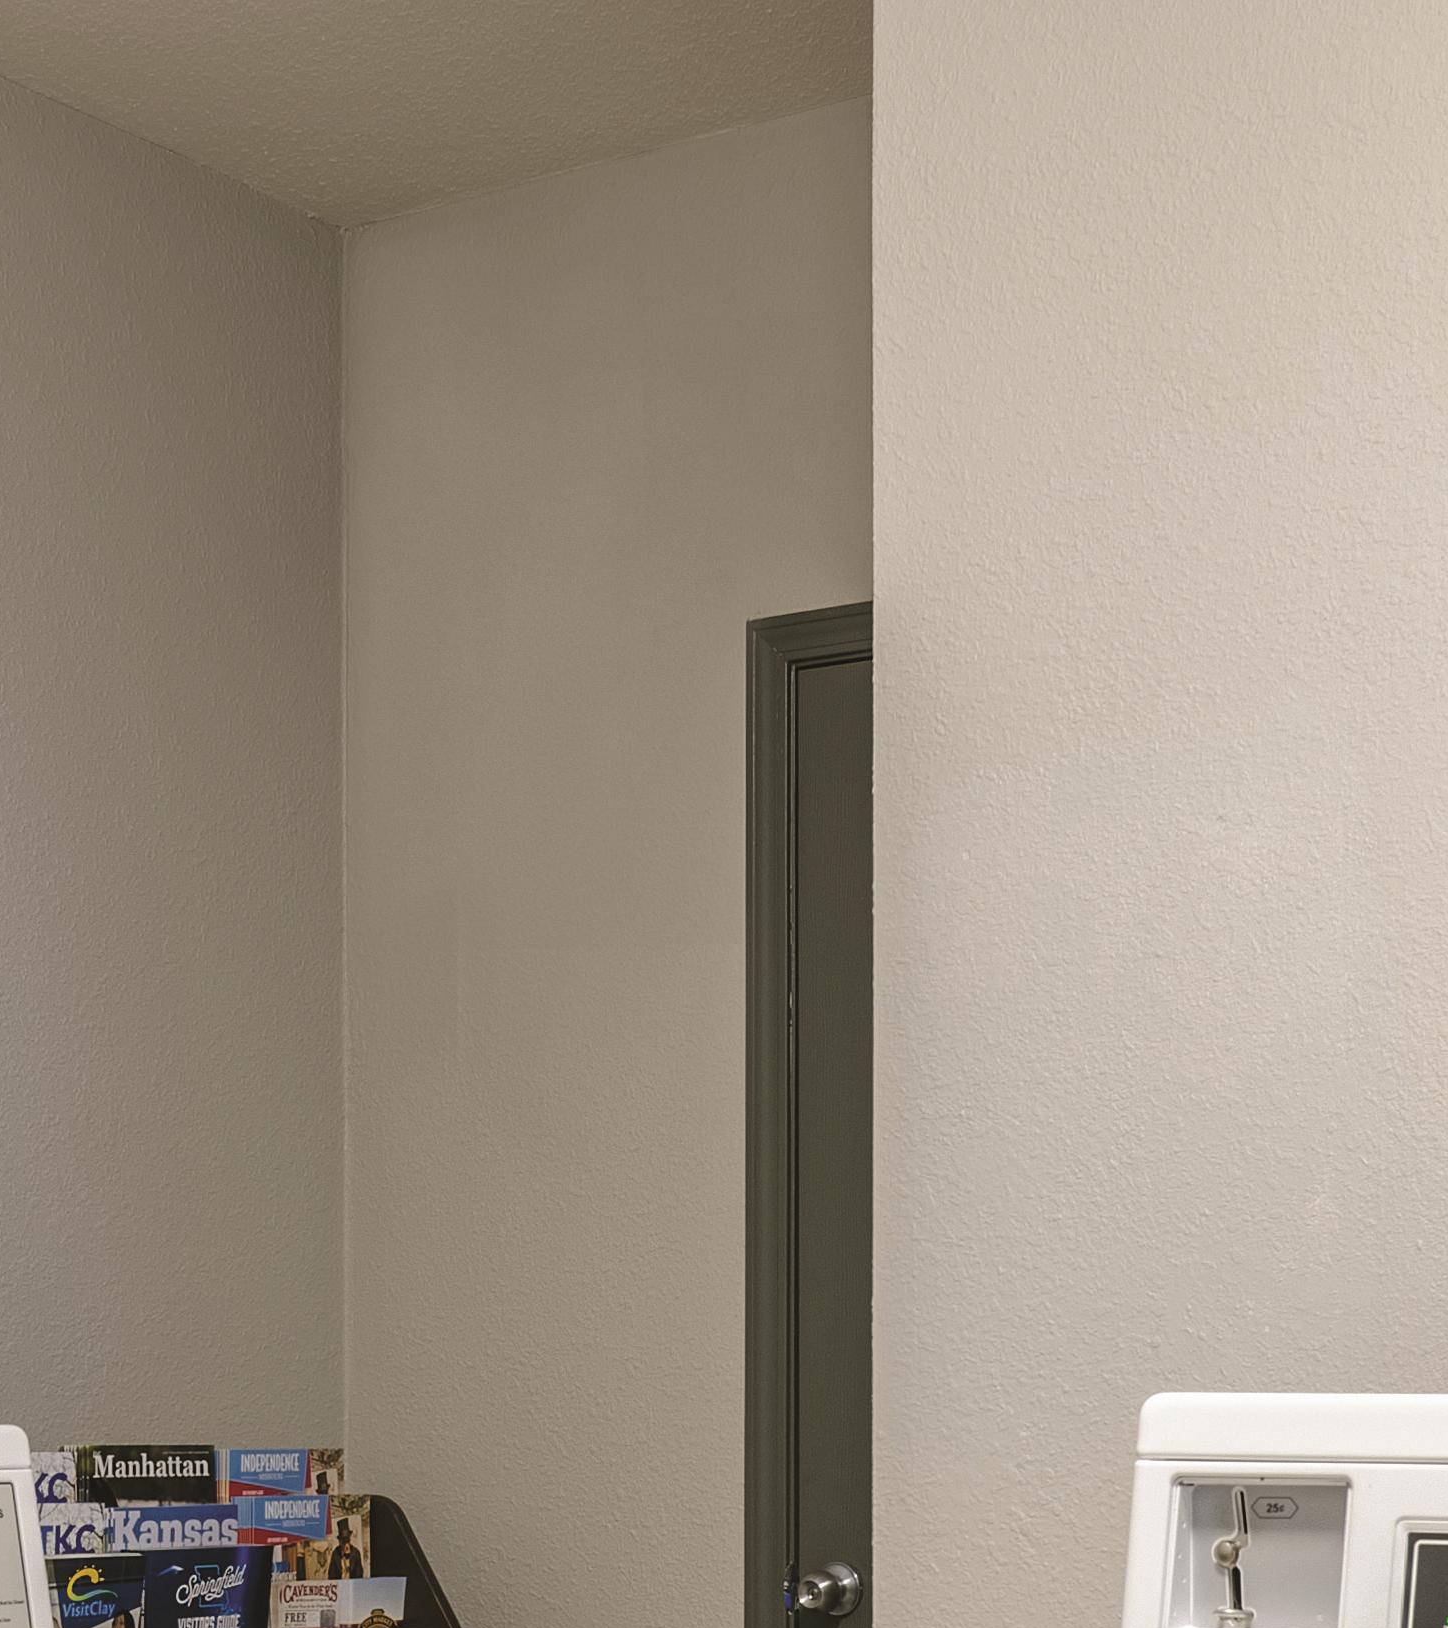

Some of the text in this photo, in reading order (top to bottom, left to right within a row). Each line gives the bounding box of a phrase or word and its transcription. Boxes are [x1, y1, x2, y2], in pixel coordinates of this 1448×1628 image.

[93, 1453, 210, 1478] Manhattan
[241, 1454, 299, 1472] INDEPENDENCE
[265, 1500, 320, 1519] INDEPENDENCE
[1266, 1503, 1286, 1513] 25¢
[113, 1511, 238, 1552] Kansas
[176, 1563, 247, 1607] Springfield
[280, 1584, 337, 1602] CAVENDER'S
[63, 1602, 116, 1618] VisitClay
[285, 1613, 307, 1623] FREE
